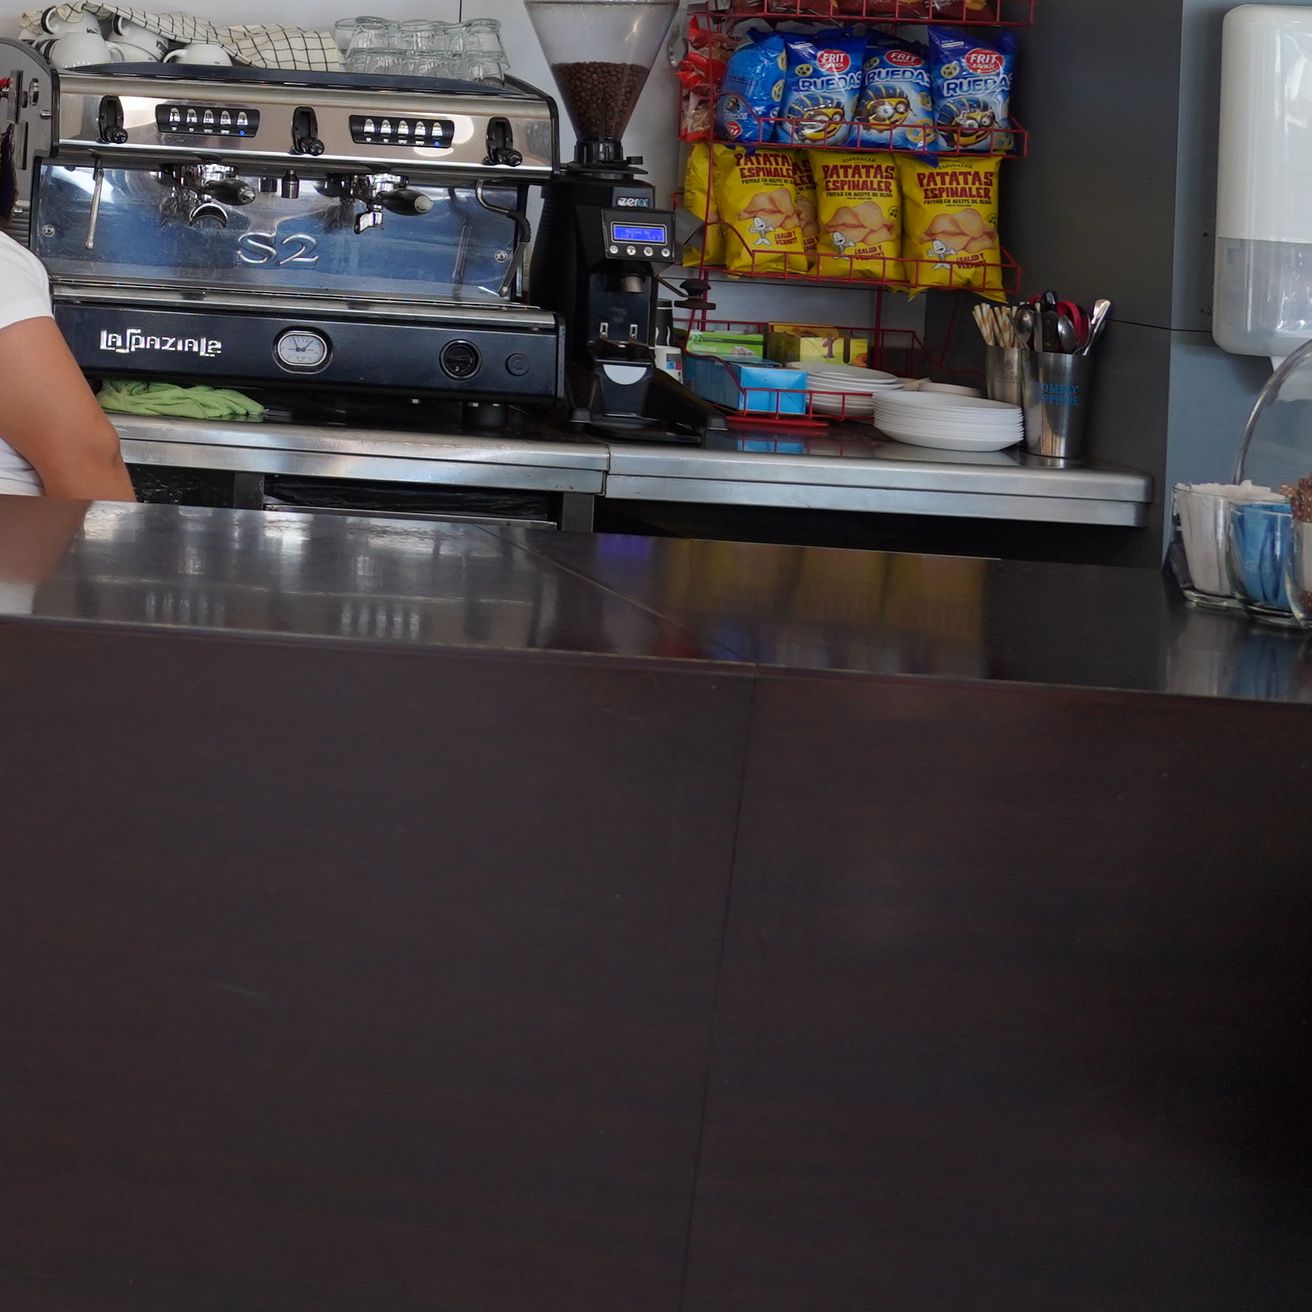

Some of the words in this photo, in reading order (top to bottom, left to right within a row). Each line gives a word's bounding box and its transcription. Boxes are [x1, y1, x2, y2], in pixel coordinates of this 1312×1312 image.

[822, 53, 845, 63] FRIT
[890, 50, 917, 62] FRIT
[970, 53, 998, 64] FRIT
[734, 154, 792, 167] PATATA
[739, 166, 793, 178] ESPINALE
[821, 164, 895, 180] PATATAS
[916, 171, 994, 187] PATATAS
[825, 180, 892, 192] ESPINALER
[923, 187, 992, 199] ESPINALER
[237, 232, 319, 265] S2
